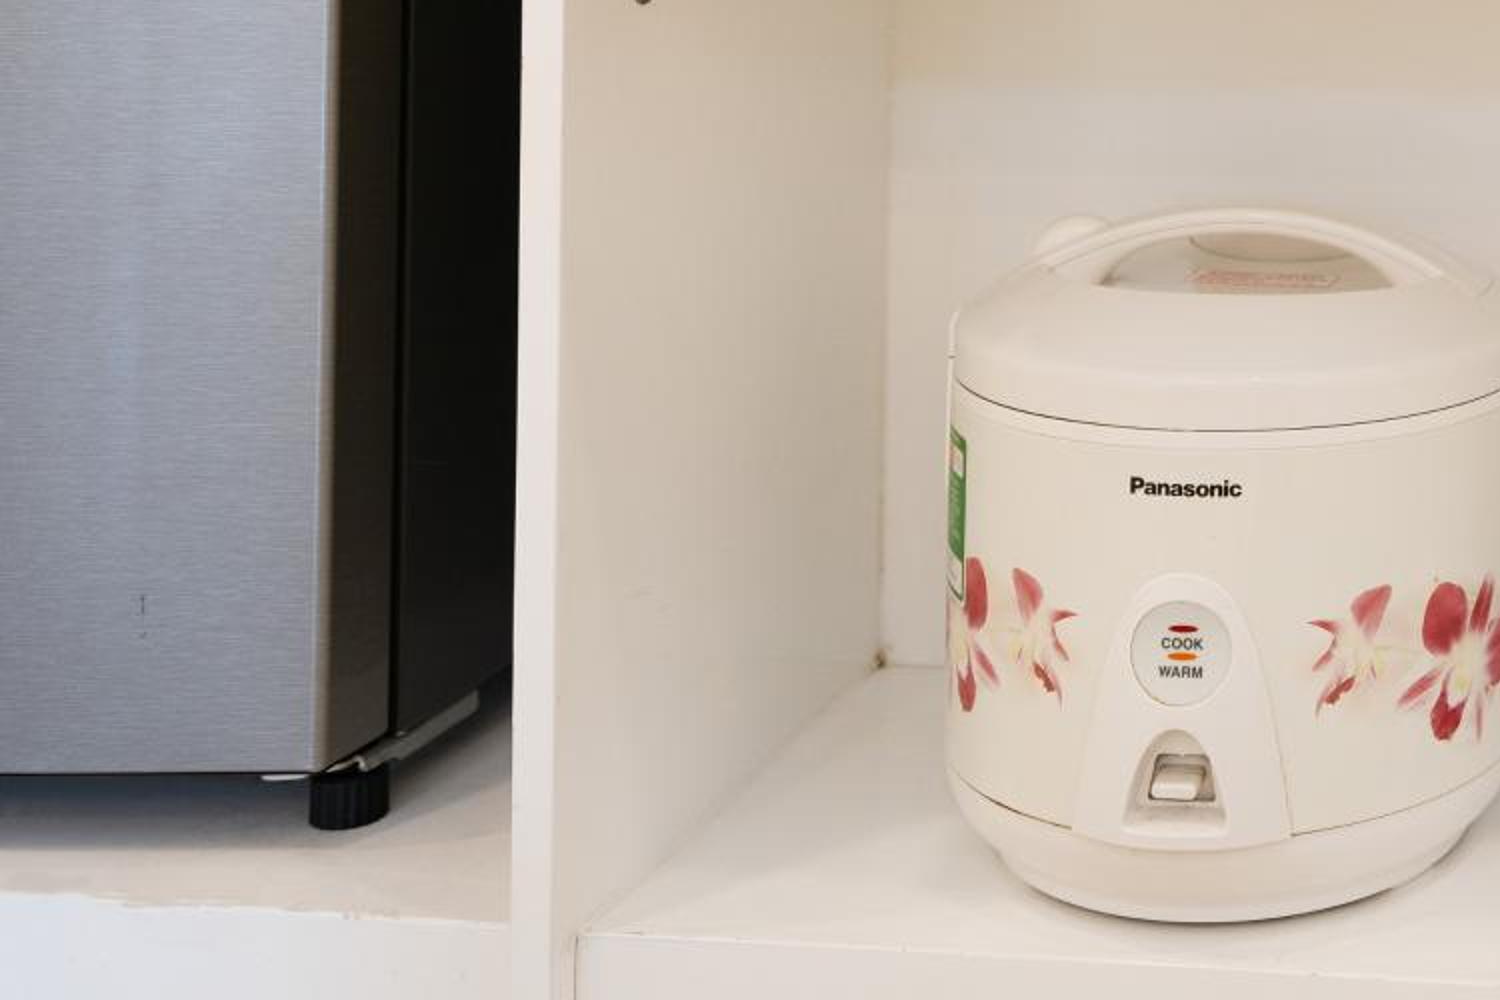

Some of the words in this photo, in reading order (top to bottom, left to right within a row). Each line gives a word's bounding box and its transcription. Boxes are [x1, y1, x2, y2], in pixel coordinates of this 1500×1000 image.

[1129, 476, 1243, 498] Panasonic
[1161, 637, 1204, 650] COOK
[1158, 665, 1203, 679] WARM
